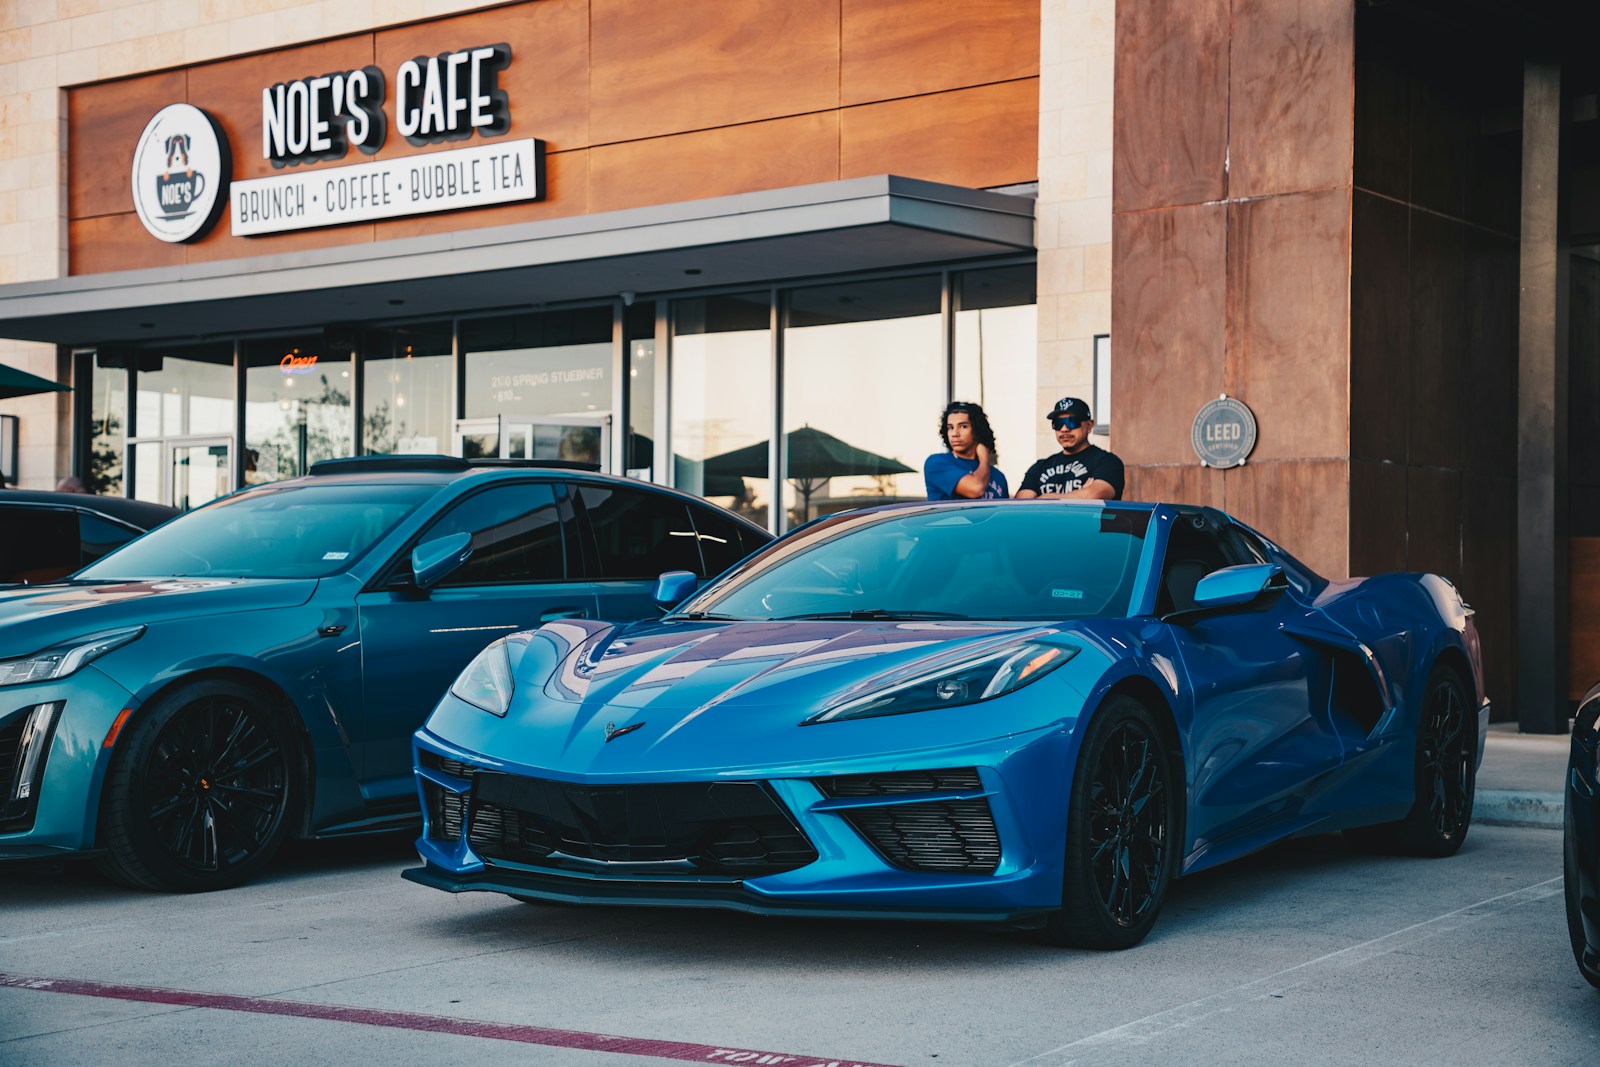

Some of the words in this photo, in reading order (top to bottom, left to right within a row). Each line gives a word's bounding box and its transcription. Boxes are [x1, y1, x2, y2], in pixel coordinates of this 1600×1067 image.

[262, 70, 369, 160] NOE'S
[396, 47, 495, 137] CAFE
[161, 181, 192, 206] NOE'S
[239, 184, 305, 224] BRUNCH
[325, 171, 392, 212] COFFEE
[411, 159, 481, 202] BUBBLE
[490, 152, 524, 191] TEA
[280, 353, 319, 374] Open
[512, 372, 548, 387] SPRING
[550, 367, 604, 383] STUEBNER
[1206, 423, 1240, 441] LEED
[1039, 479, 1083, 495] TEXNS
